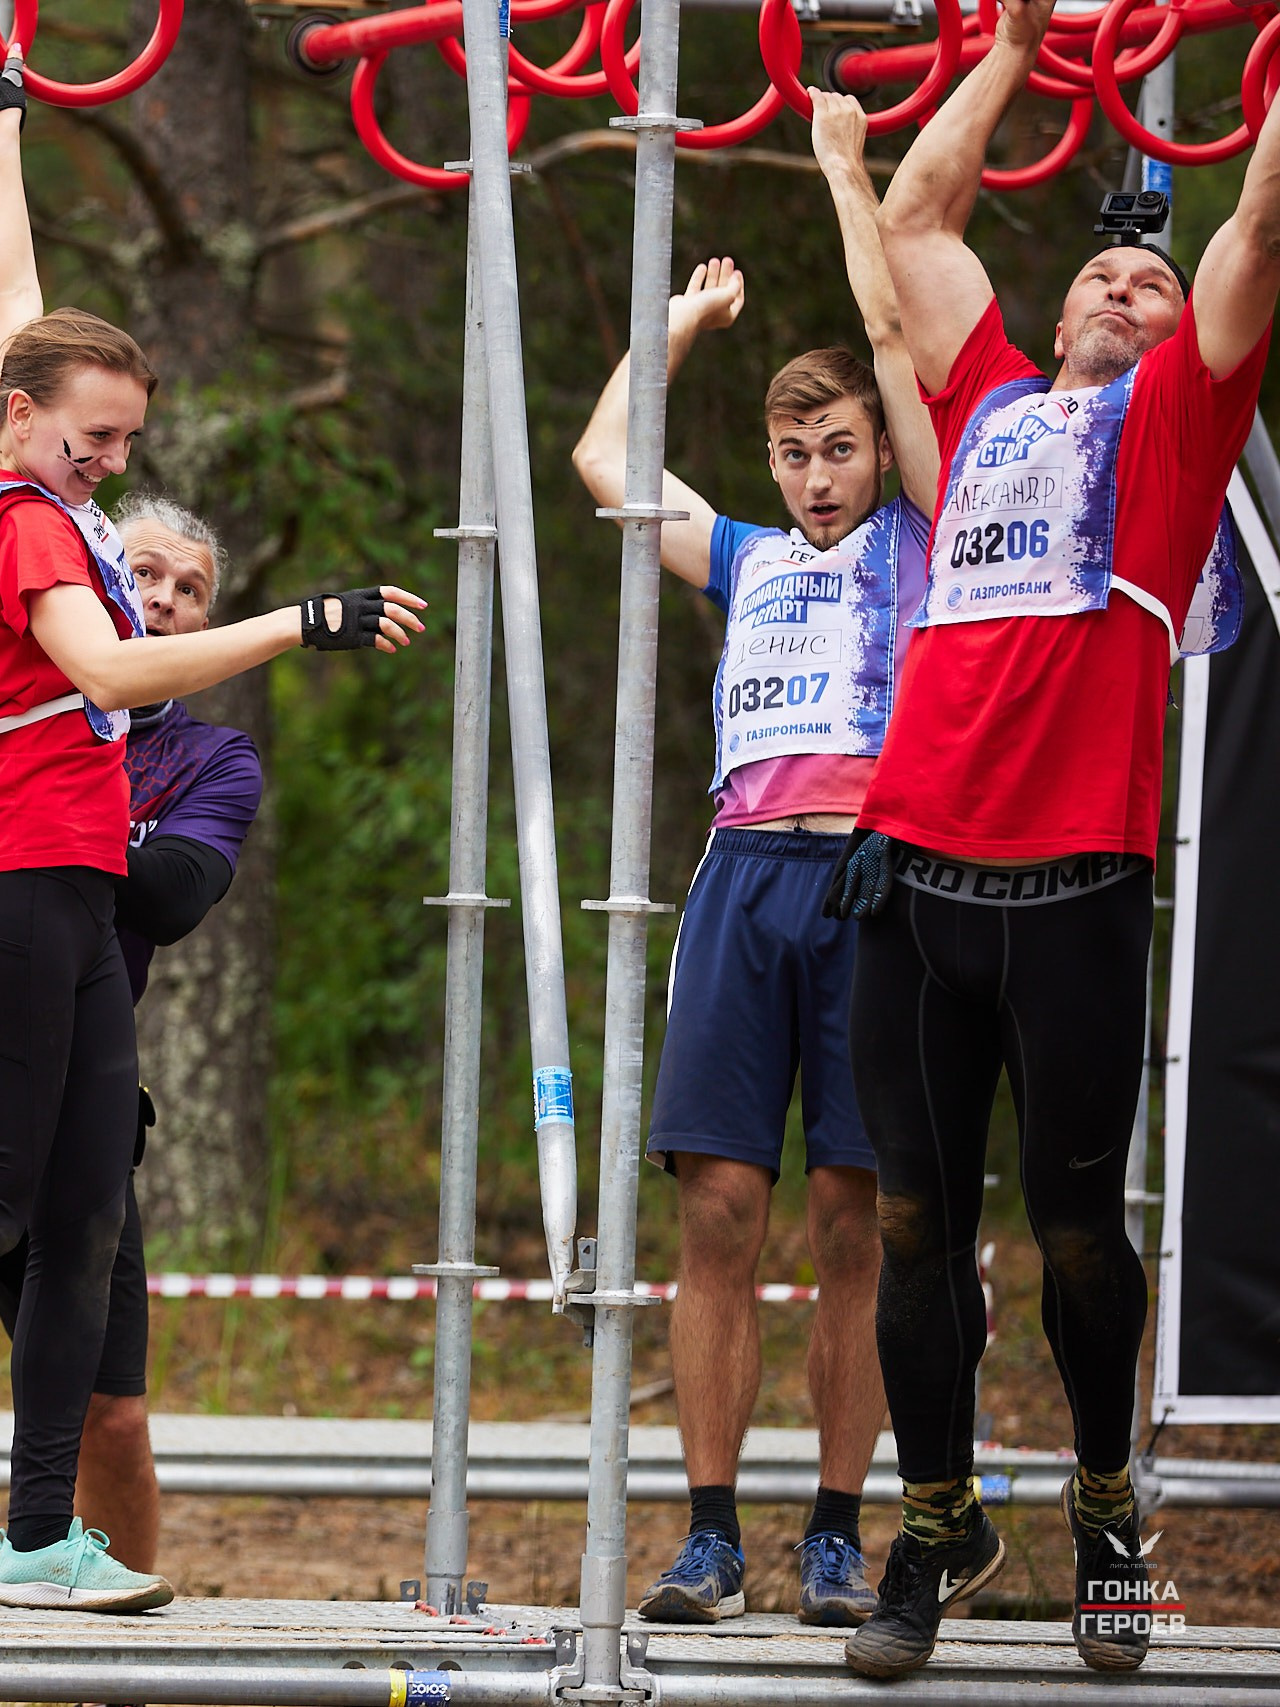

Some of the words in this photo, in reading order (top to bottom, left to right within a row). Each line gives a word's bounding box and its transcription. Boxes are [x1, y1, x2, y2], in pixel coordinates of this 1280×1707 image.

[949, 476, 1055, 514] АЛЕКСАНДР
[950, 519, 1049, 569] 03206
[740, 572, 840, 619] КОМАНДНЫЙ
[970, 581, 1052, 601] ГАЗПРОМБАНК
[753, 600, 805, 626] СТАРТ
[729, 671, 830, 719] 03207
[746, 723, 832, 742] ГАЗПРОМБАНК
